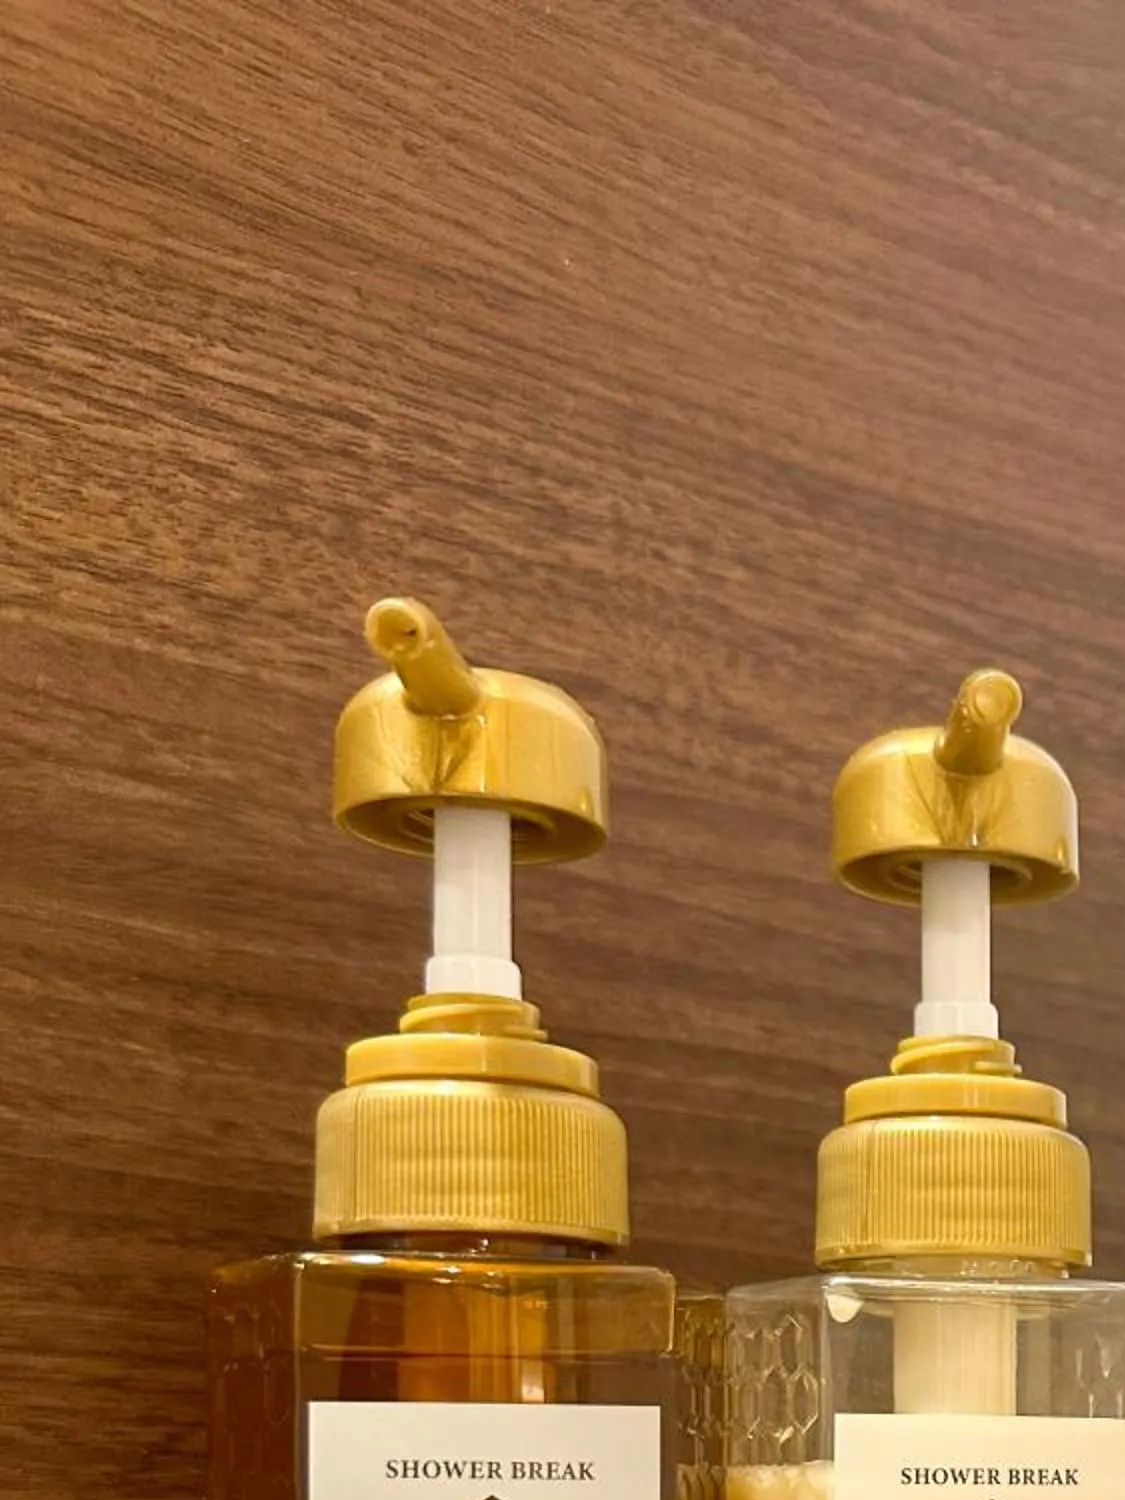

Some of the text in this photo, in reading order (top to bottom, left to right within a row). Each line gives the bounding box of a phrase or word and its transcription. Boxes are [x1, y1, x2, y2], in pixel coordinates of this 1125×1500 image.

[386, 1459, 595, 1481] SHOWER BREAK
[900, 1467, 1079, 1486] SHOWER BREAK
